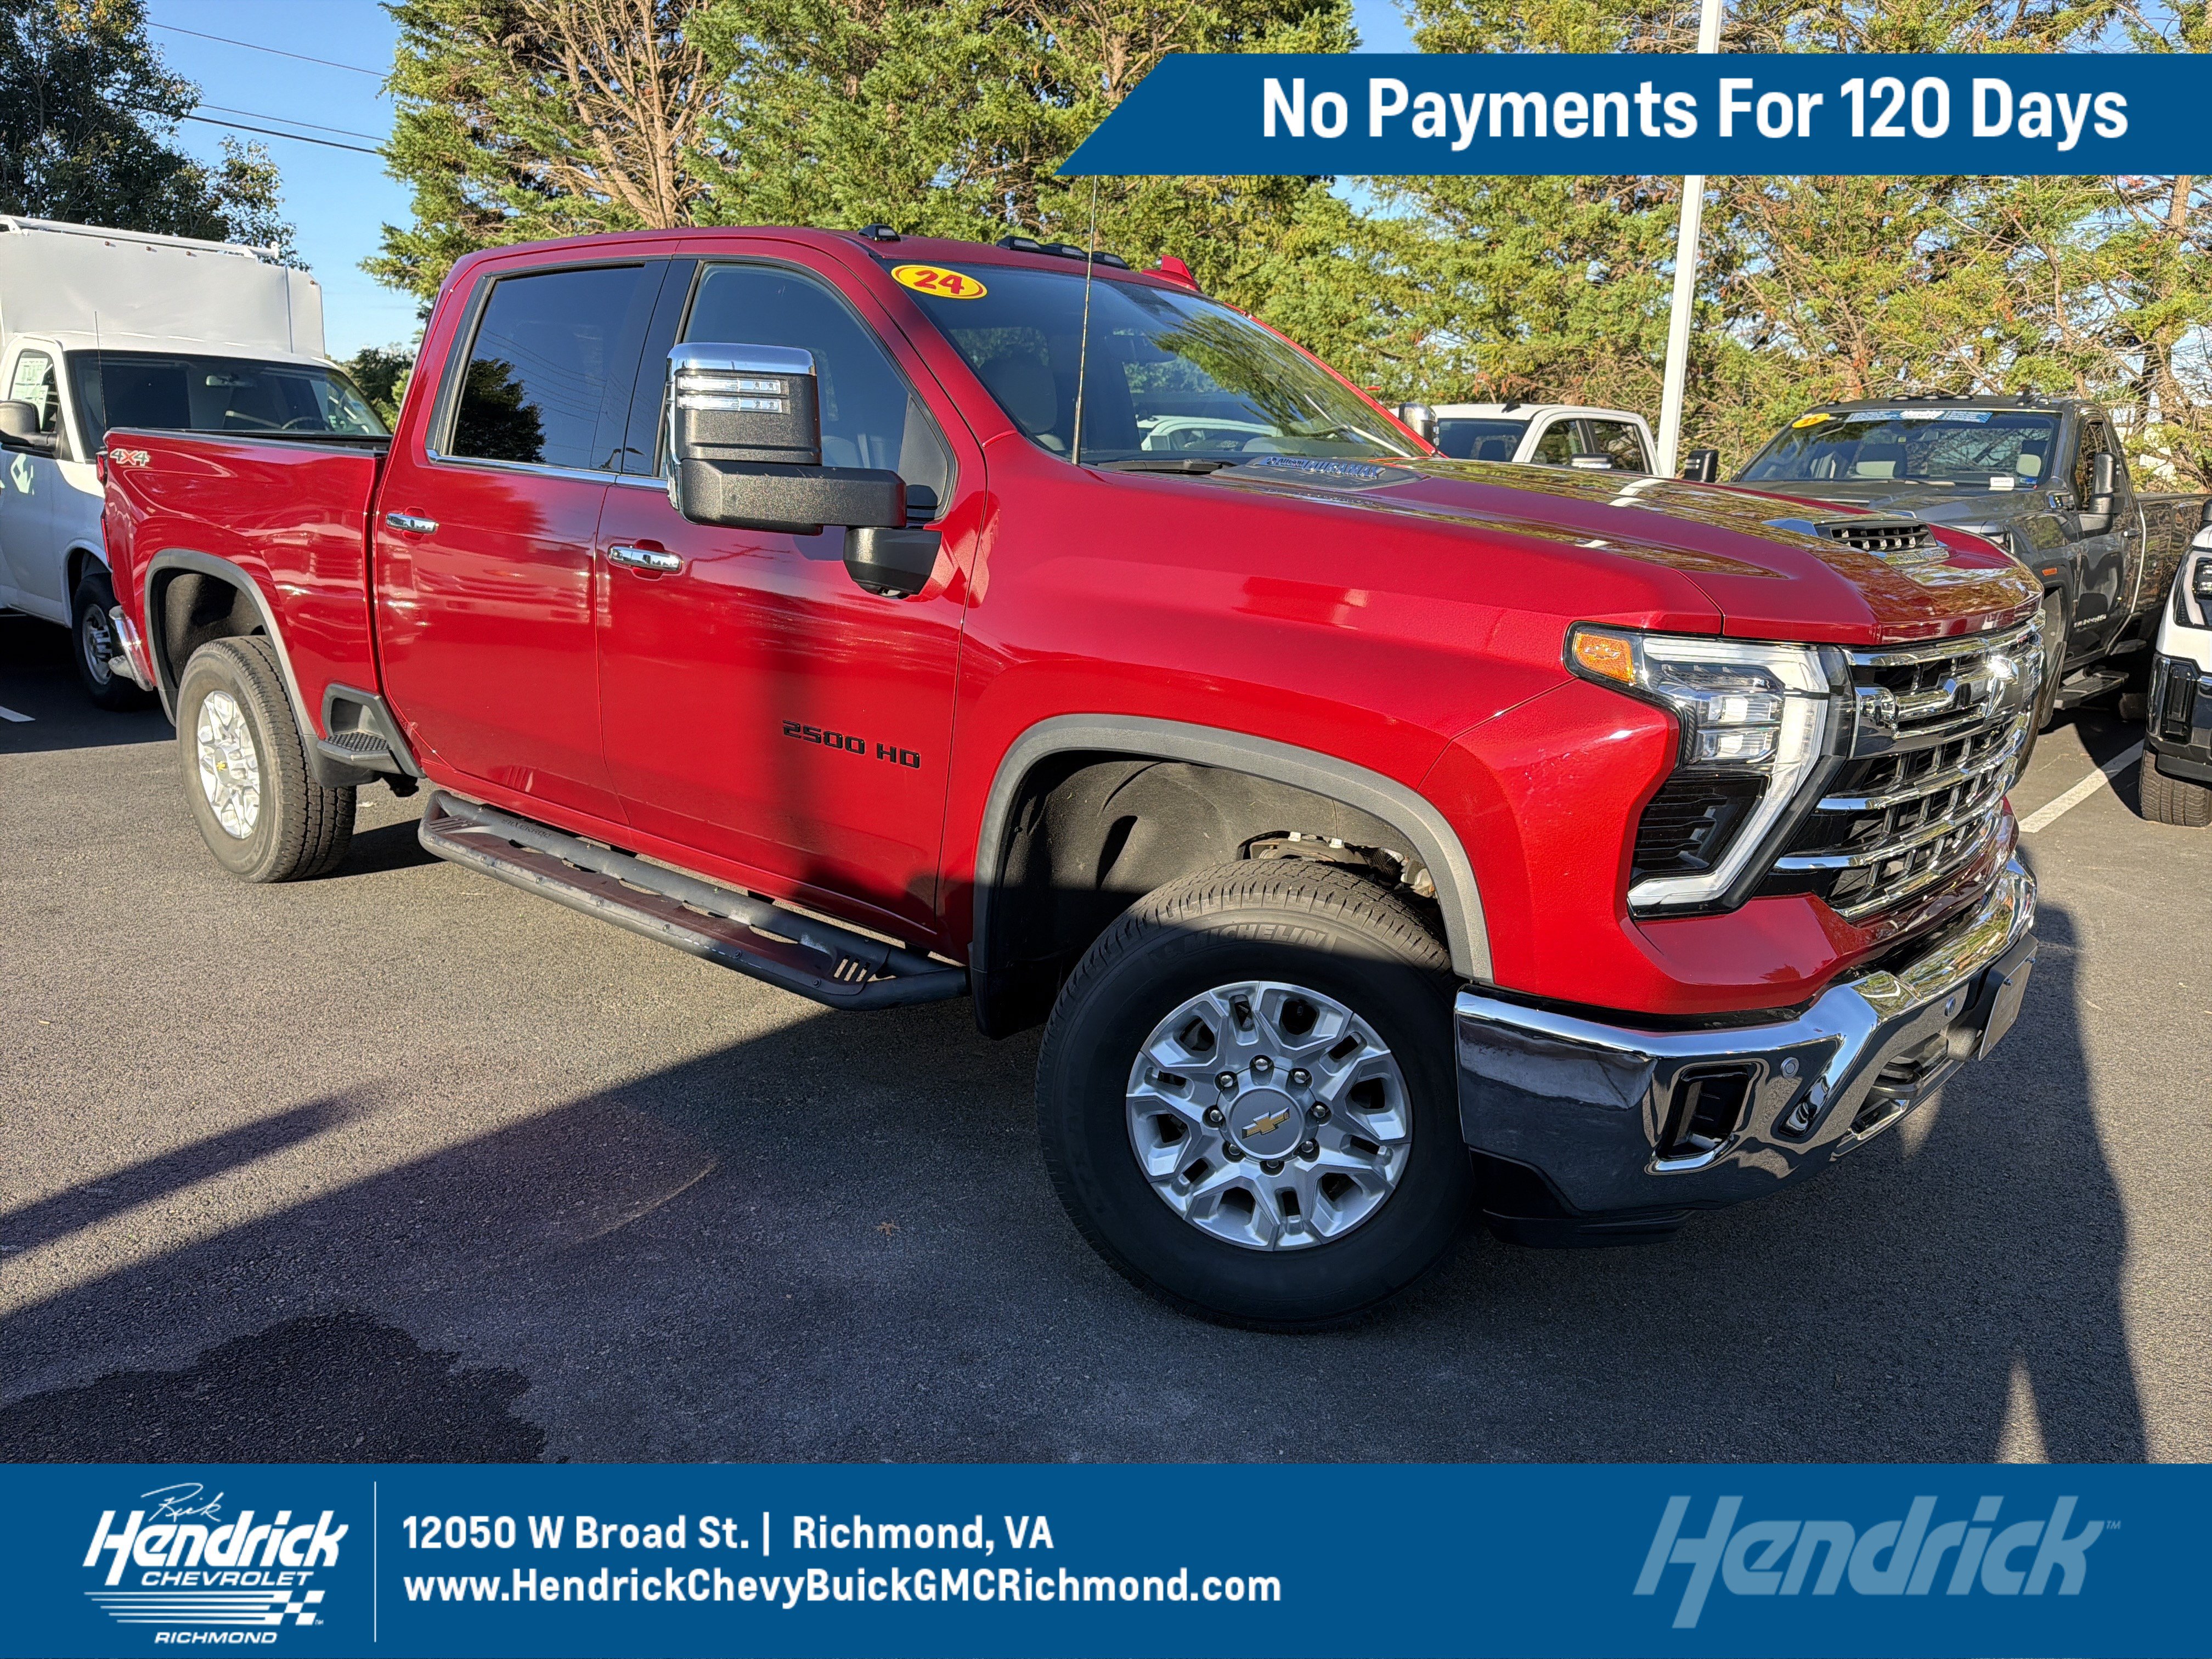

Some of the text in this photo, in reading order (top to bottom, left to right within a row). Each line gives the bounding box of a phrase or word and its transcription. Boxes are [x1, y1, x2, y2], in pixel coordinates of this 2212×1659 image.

[913, 270, 964, 294] 24
[782, 720, 921, 769] 2500 HD
[1184, 924, 1326, 953] MICHELIN
